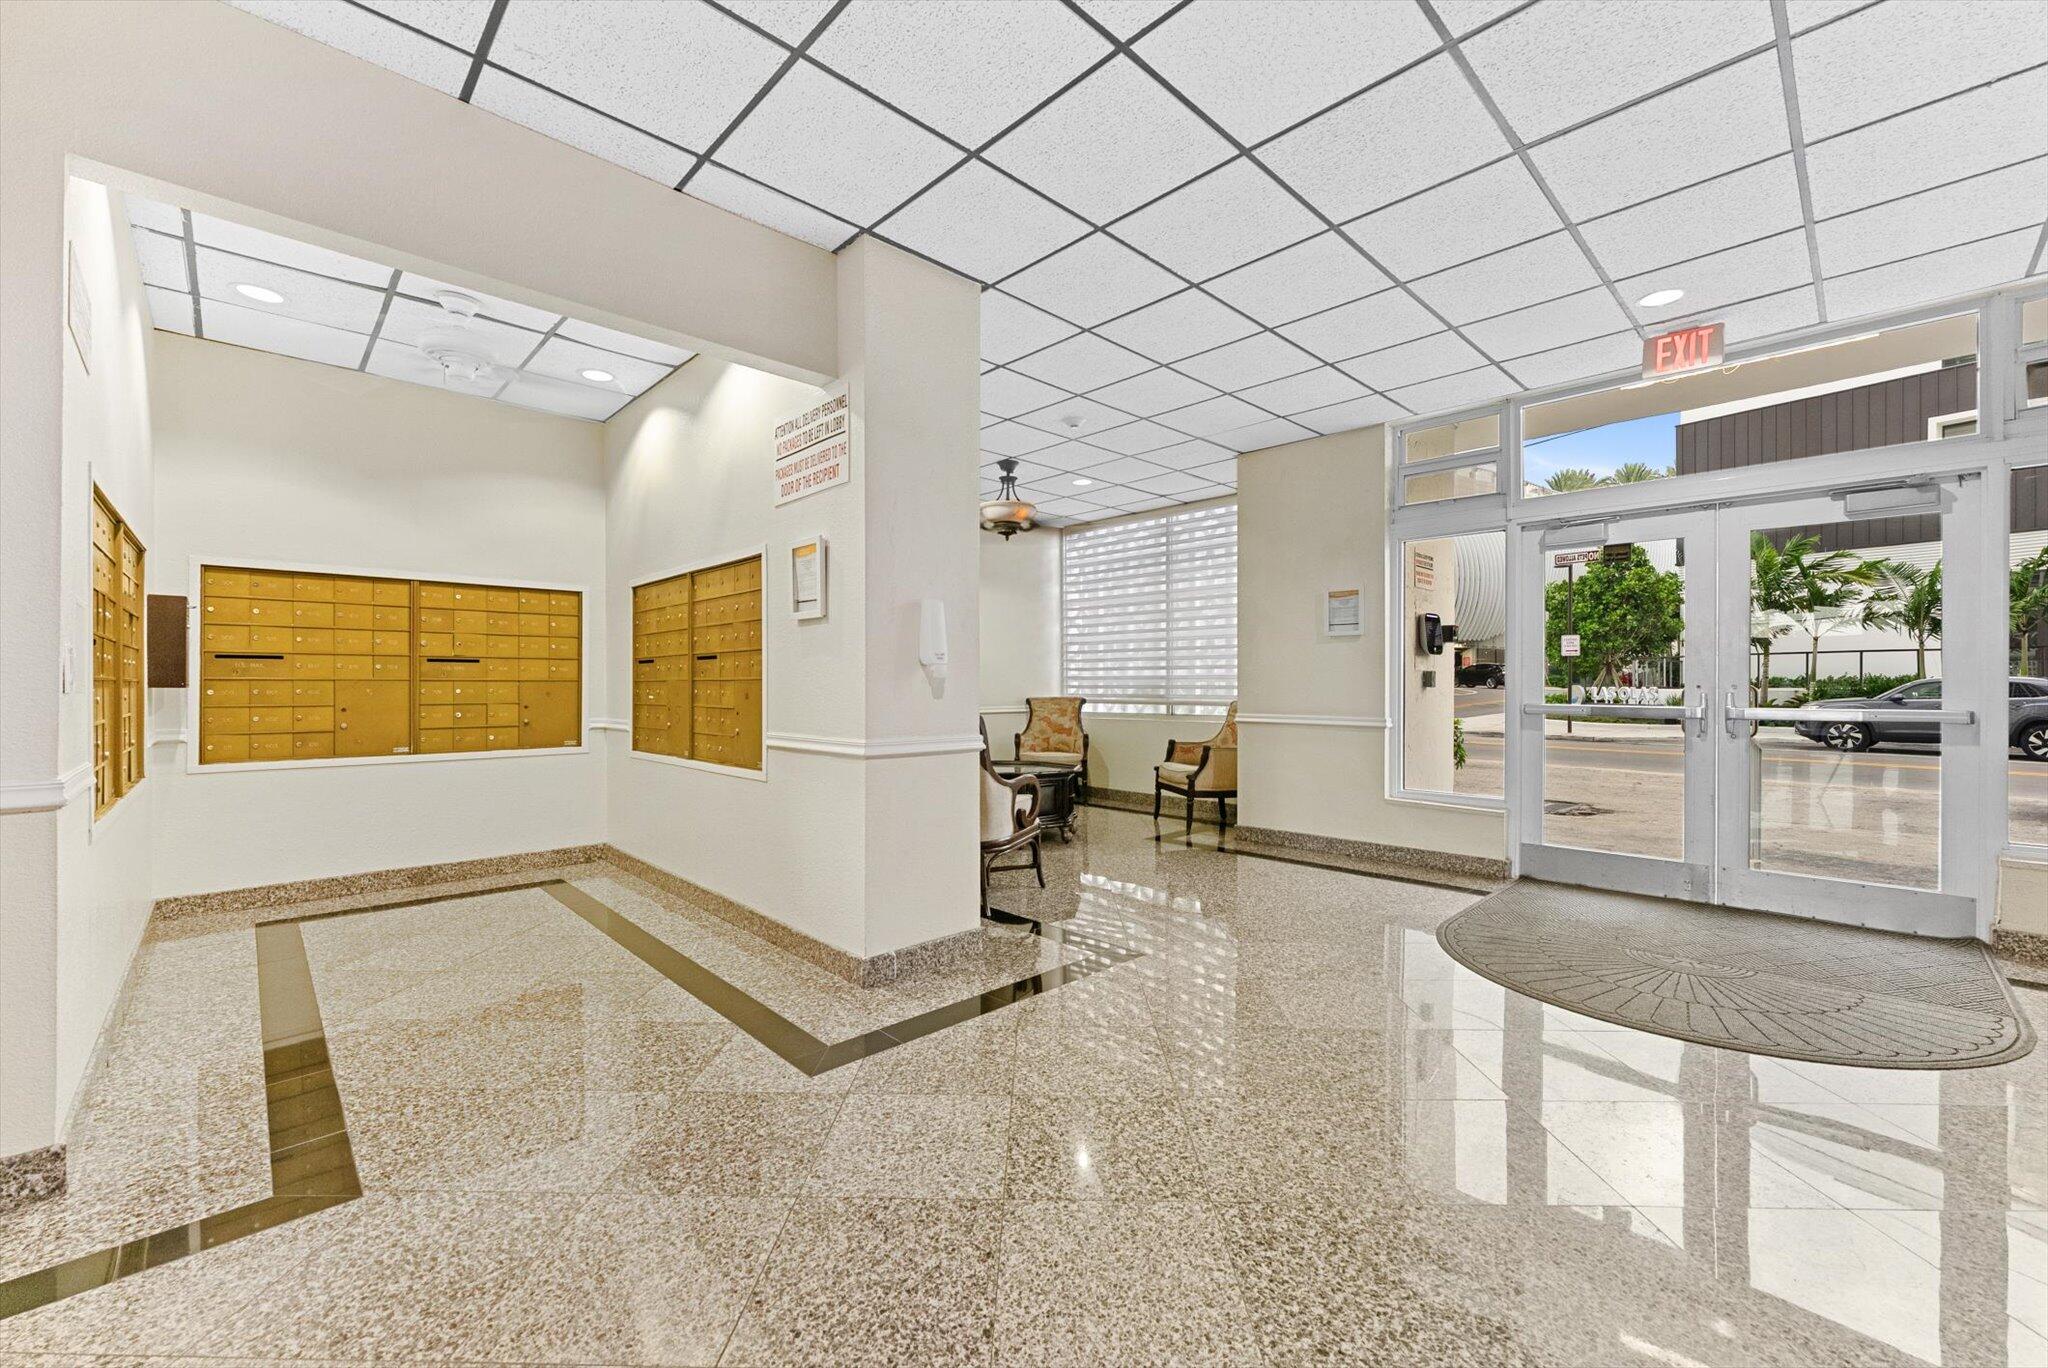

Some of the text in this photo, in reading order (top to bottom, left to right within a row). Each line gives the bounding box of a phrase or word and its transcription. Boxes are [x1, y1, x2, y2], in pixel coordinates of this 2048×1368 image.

[1656, 327, 1714, 373] EXIT
[802, 407, 820, 427] DELIVERY
[821, 394, 847, 417] PERSONNEL
[782, 434, 801, 452] PACKAGES
[814, 424, 823, 440] LEFT
[830, 415, 845, 432] LOBBY
[781, 480, 794, 497] DOOR
[813, 463, 839, 486] RECIPIENT
[1591, 686, 1659, 701] LAS OLAS
